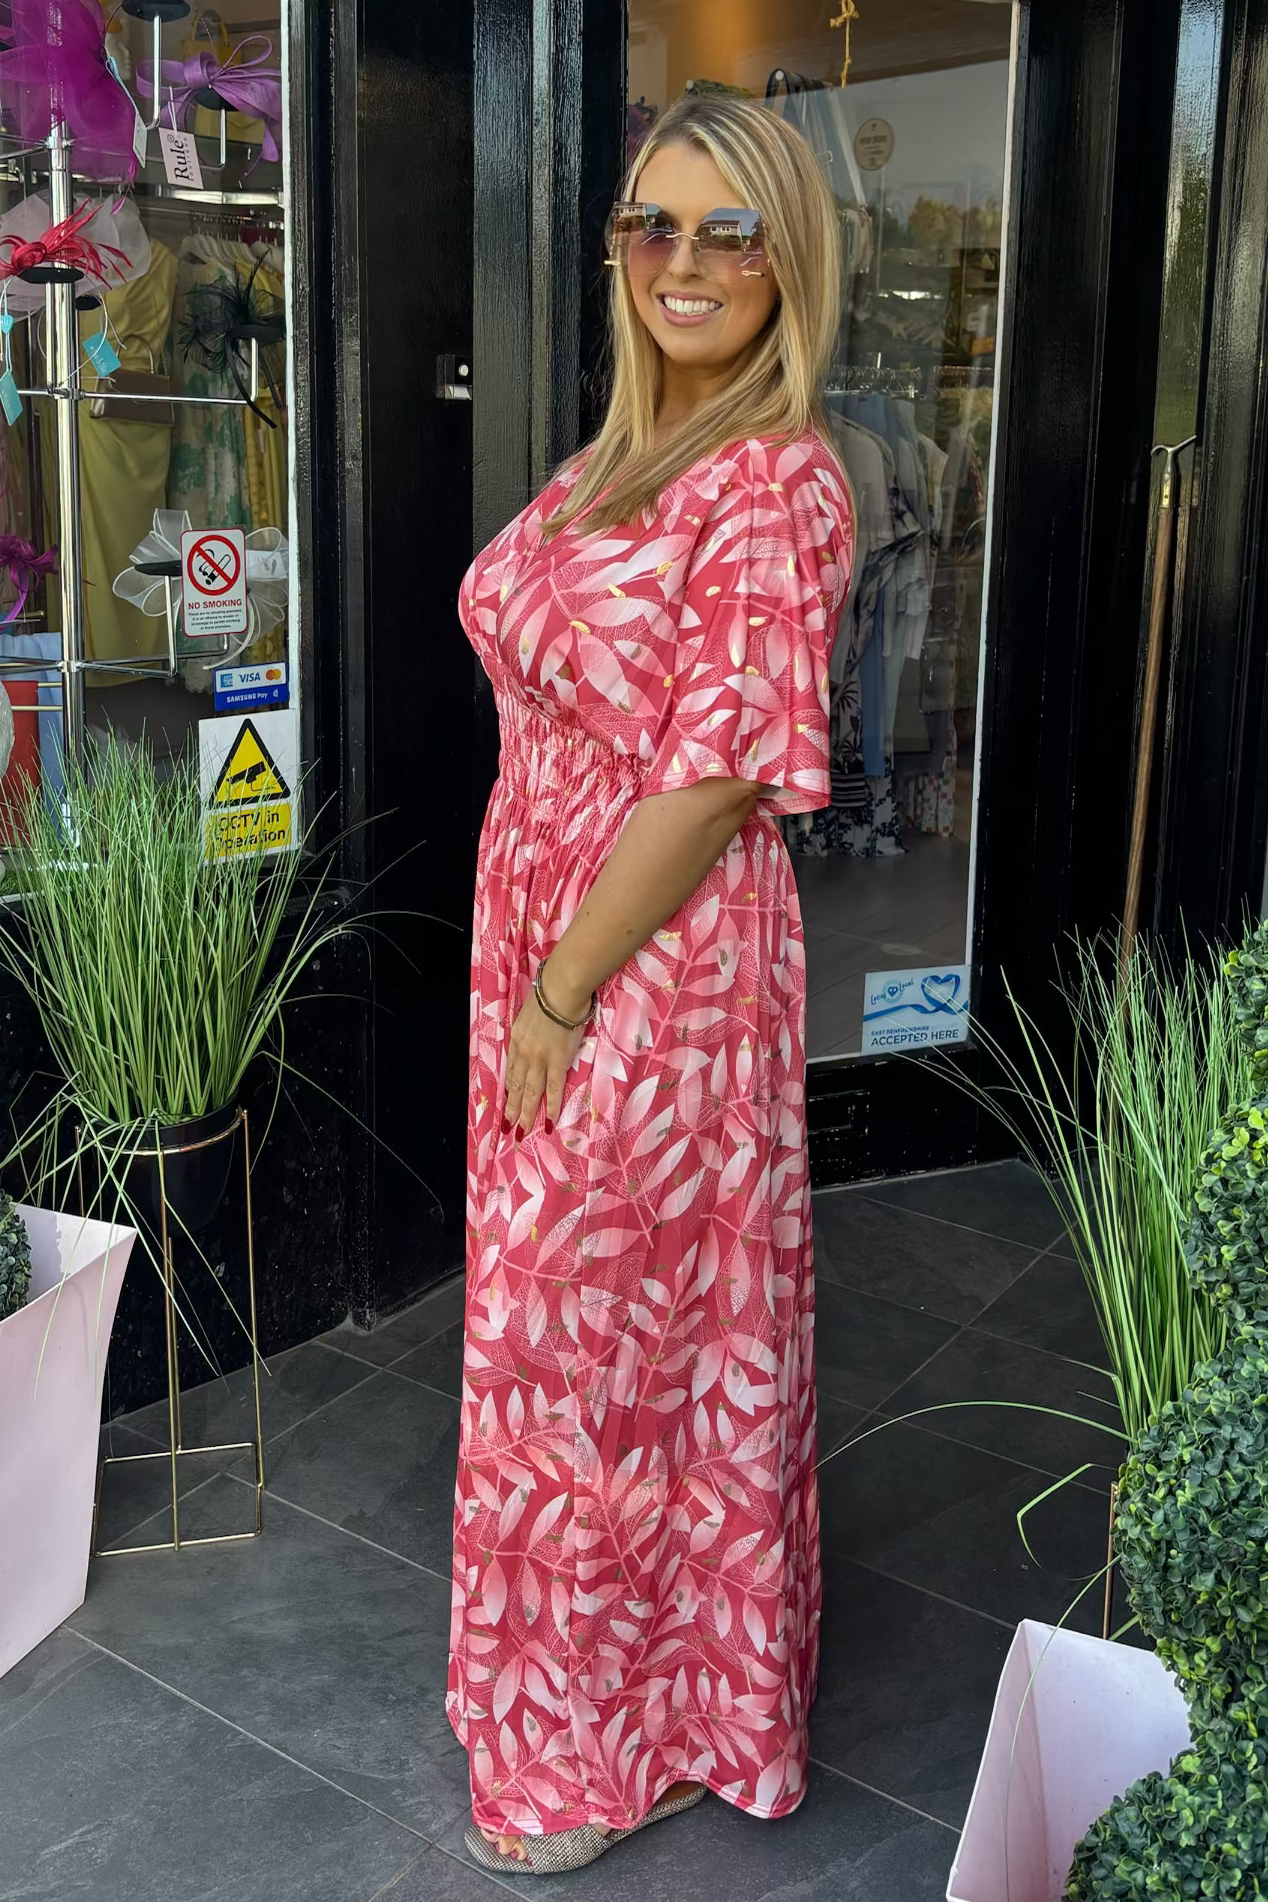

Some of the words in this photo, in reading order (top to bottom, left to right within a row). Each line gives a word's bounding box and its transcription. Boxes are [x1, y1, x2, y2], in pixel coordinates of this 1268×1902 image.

[170, 140, 190, 180] Rule
[188, 601, 201, 610] NO
[203, 599, 242, 608] SMOKING
[239, 672, 260, 683] VISA
[227, 693, 256, 703] SAMSUNG
[220, 812, 260, 831] CCTV
[267, 810, 279, 824] in
[871, 1032, 928, 1046] ACCEPTED
[931, 1029, 959, 1040] HERE
